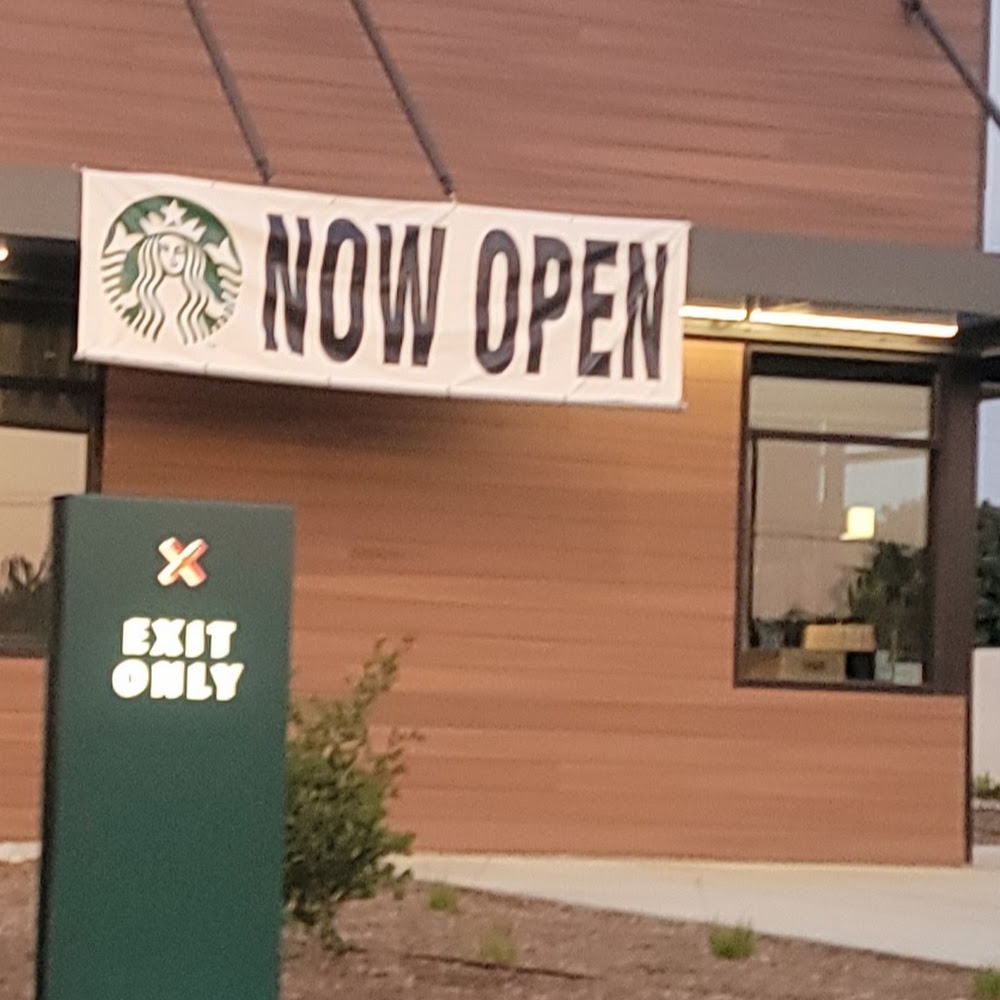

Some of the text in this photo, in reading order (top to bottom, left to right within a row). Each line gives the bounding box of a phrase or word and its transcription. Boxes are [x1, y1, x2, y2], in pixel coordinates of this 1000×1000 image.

[262, 213, 668, 380] NOW OPEN
[122, 616, 237, 660] EXIT
[112, 658, 245, 702] ONLY
